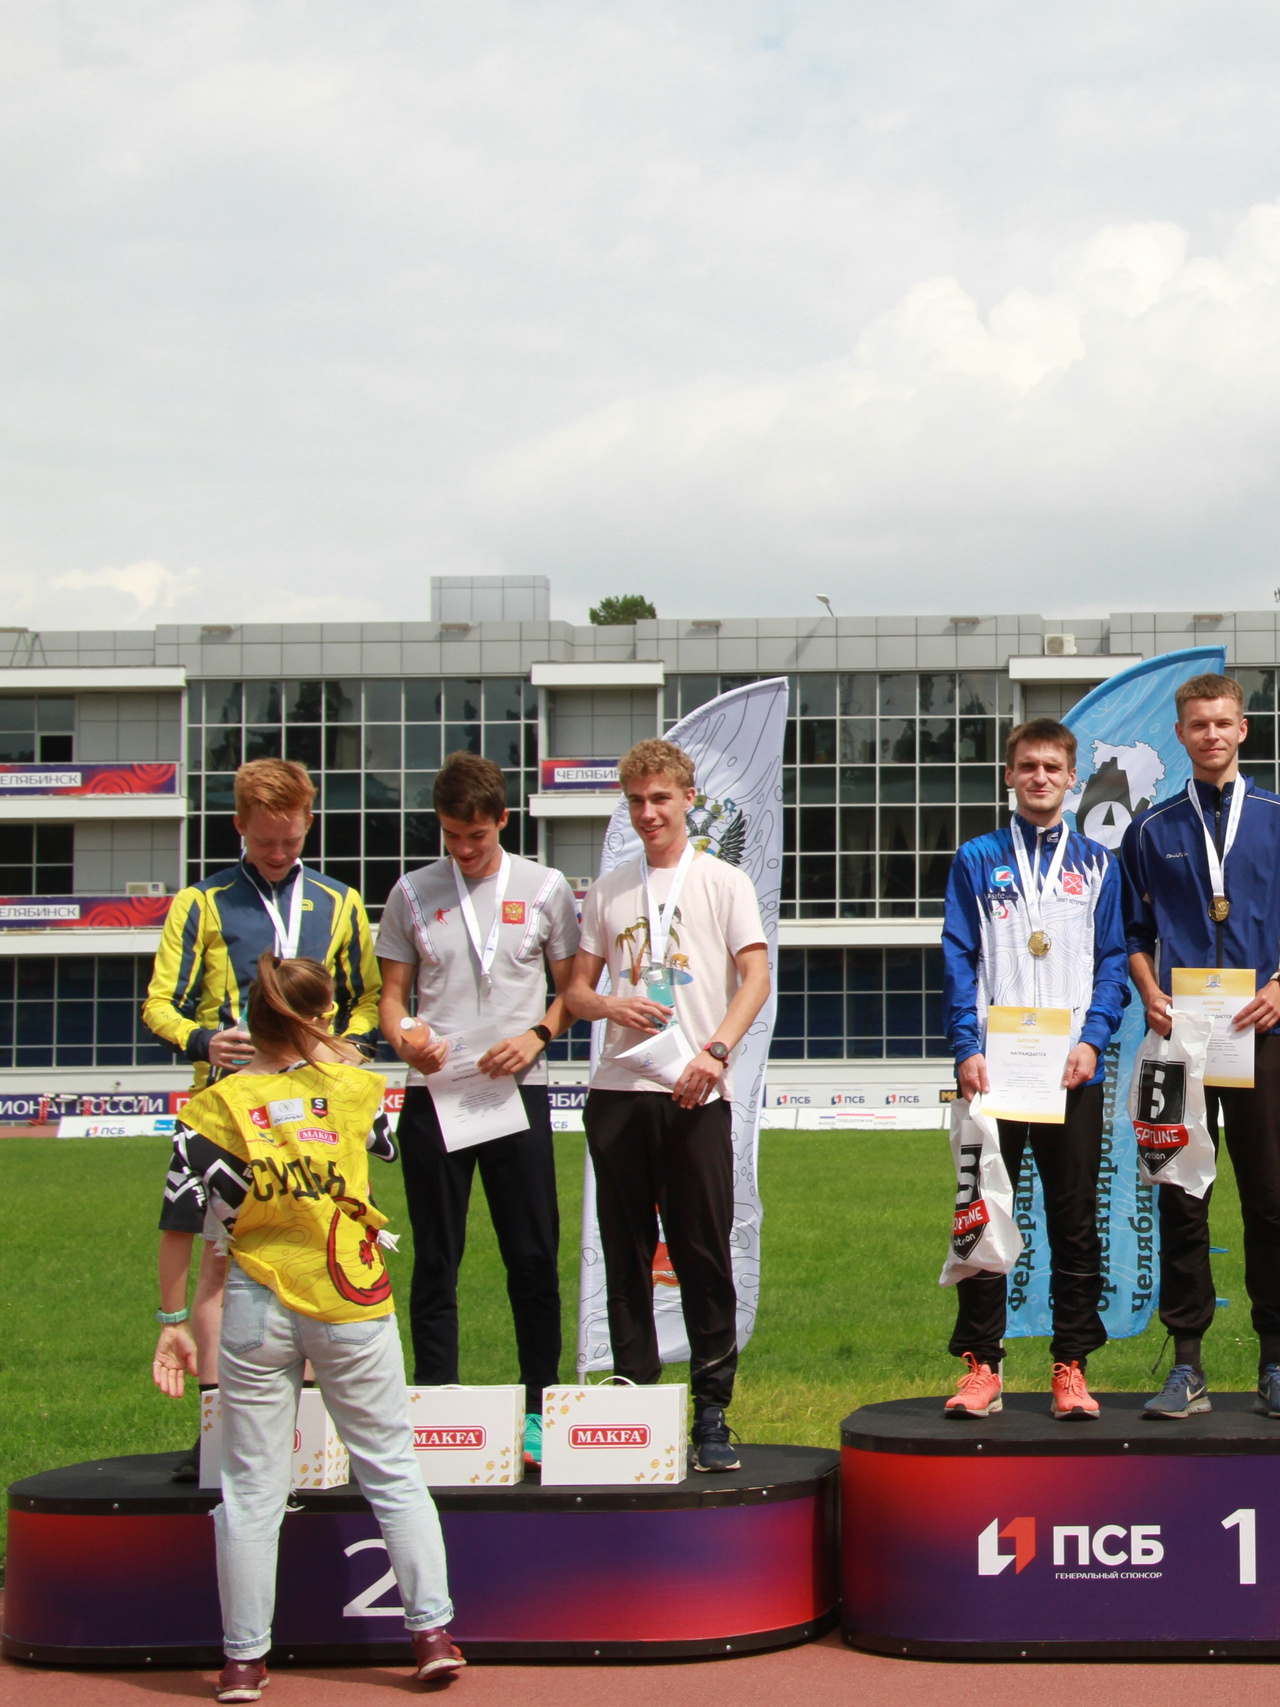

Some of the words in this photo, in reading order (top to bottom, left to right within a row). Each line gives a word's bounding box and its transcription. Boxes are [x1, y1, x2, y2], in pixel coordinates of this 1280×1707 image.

[789, 1096, 811, 1104] ПСБ
[844, 1095, 865, 1104] ПСБ
[899, 1095, 920, 1104] ПСБ
[100, 1127, 126, 1136] ПСБ
[301, 1130, 335, 1142] MAKFA
[413, 1431, 478, 1446] MAKFA
[576, 1429, 643, 1444] MAKFA
[1053, 1524, 1165, 1567] ПСБ
[1221, 1508, 1257, 1585] 1
[343, 1538, 406, 1617] 2
[1055, 1571, 1118, 1580] ГЕНЕРАЛЬНЫЙ
[1120, 1571, 1163, 1579] СПОНСОР
